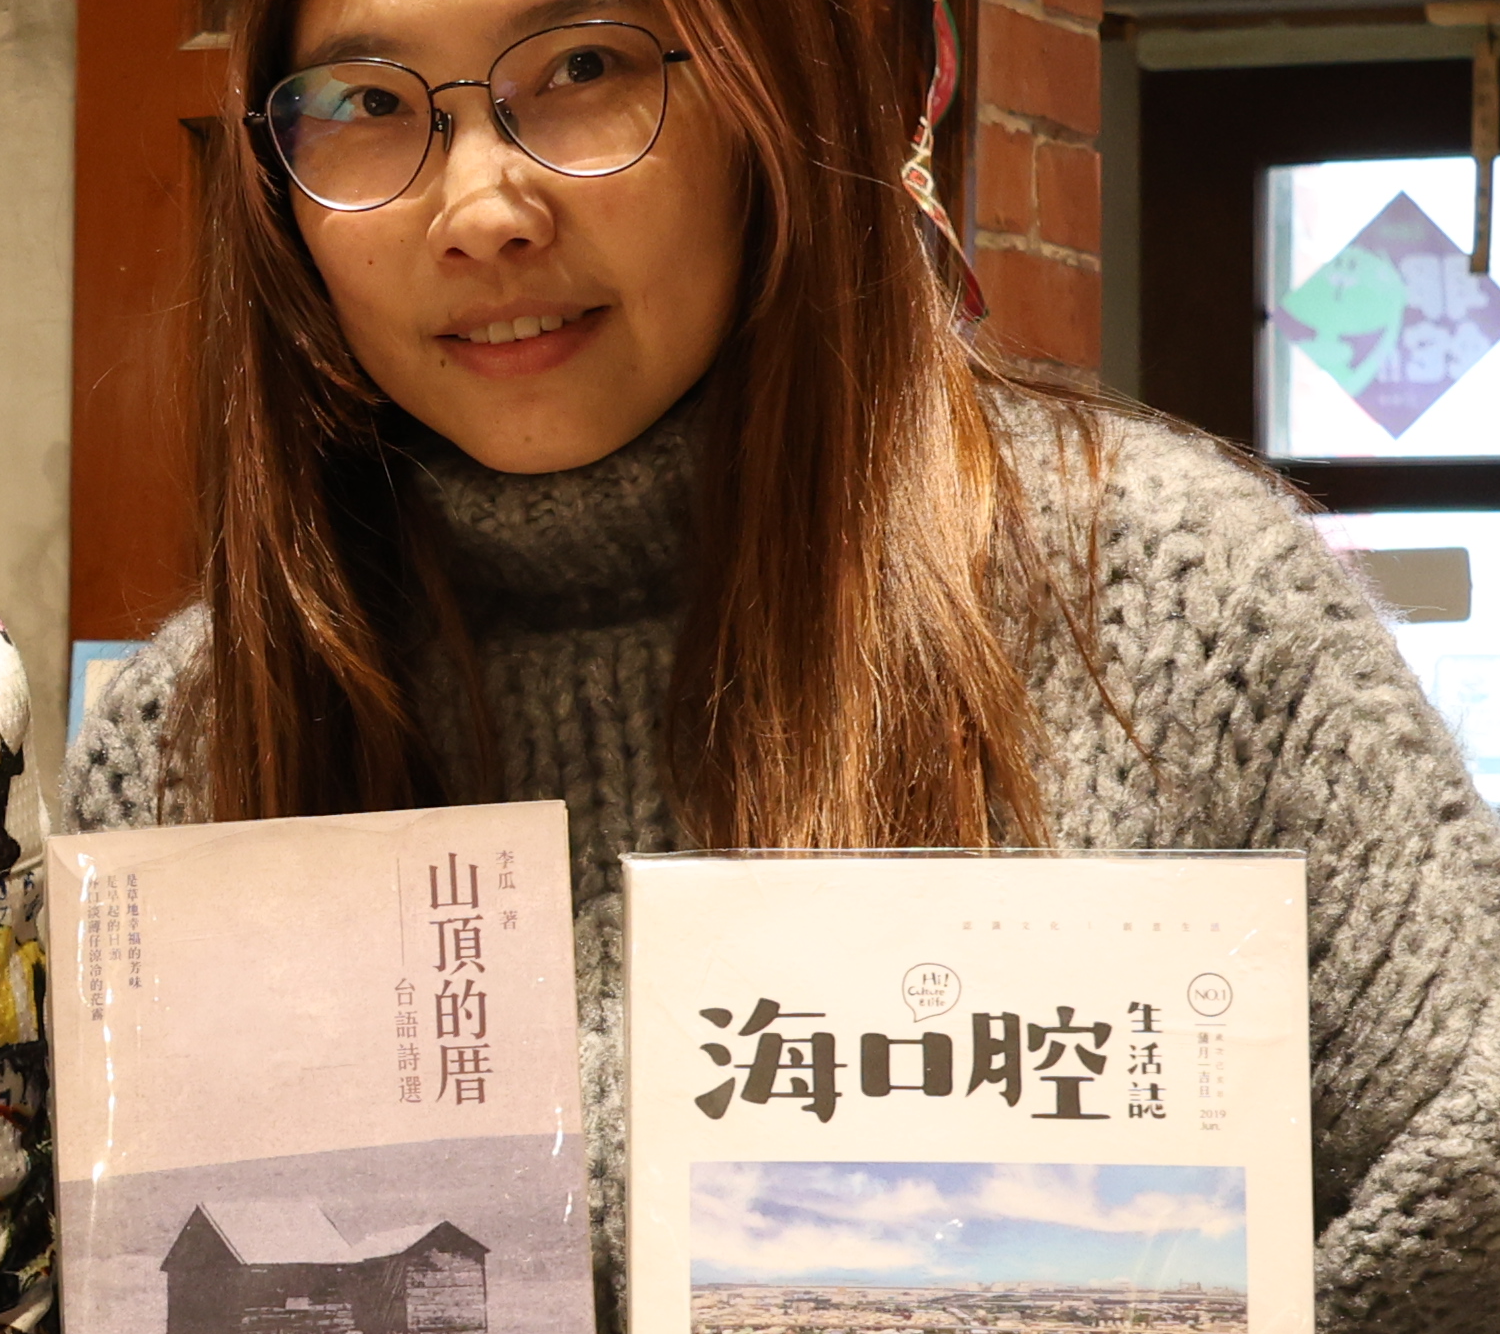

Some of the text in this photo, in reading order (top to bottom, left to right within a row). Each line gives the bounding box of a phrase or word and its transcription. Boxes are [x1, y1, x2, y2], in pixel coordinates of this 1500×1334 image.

[428, 851, 494, 1106] 山頂的厝
[499, 909, 519, 930] 著
[394, 977, 423, 1105] 台語詩選
[693, 996, 1113, 1124] 海口腔
[1126, 1000, 1168, 1120] 生活誌
[1199, 1109, 1227, 1119] 2019
